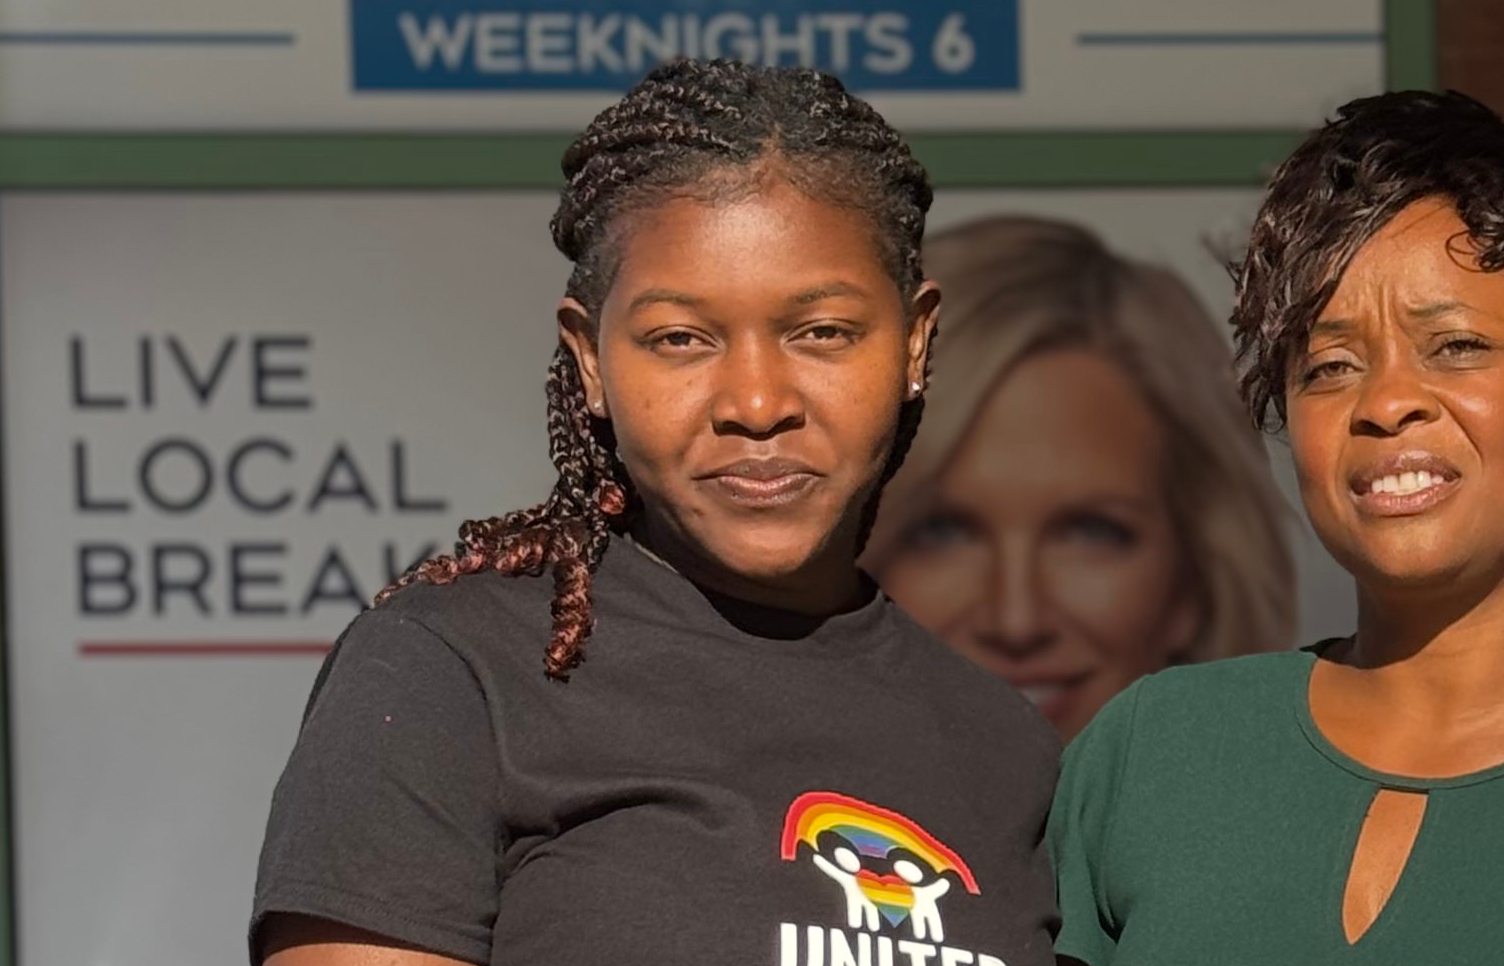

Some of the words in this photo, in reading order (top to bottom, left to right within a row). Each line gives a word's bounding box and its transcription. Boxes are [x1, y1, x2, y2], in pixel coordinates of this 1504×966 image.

[399, 13, 912, 73] WEEKNIGHTS
[932, 13, 976, 73] 6
[70, 336, 314, 410] LIVE
[73, 437, 449, 515] LOCAL
